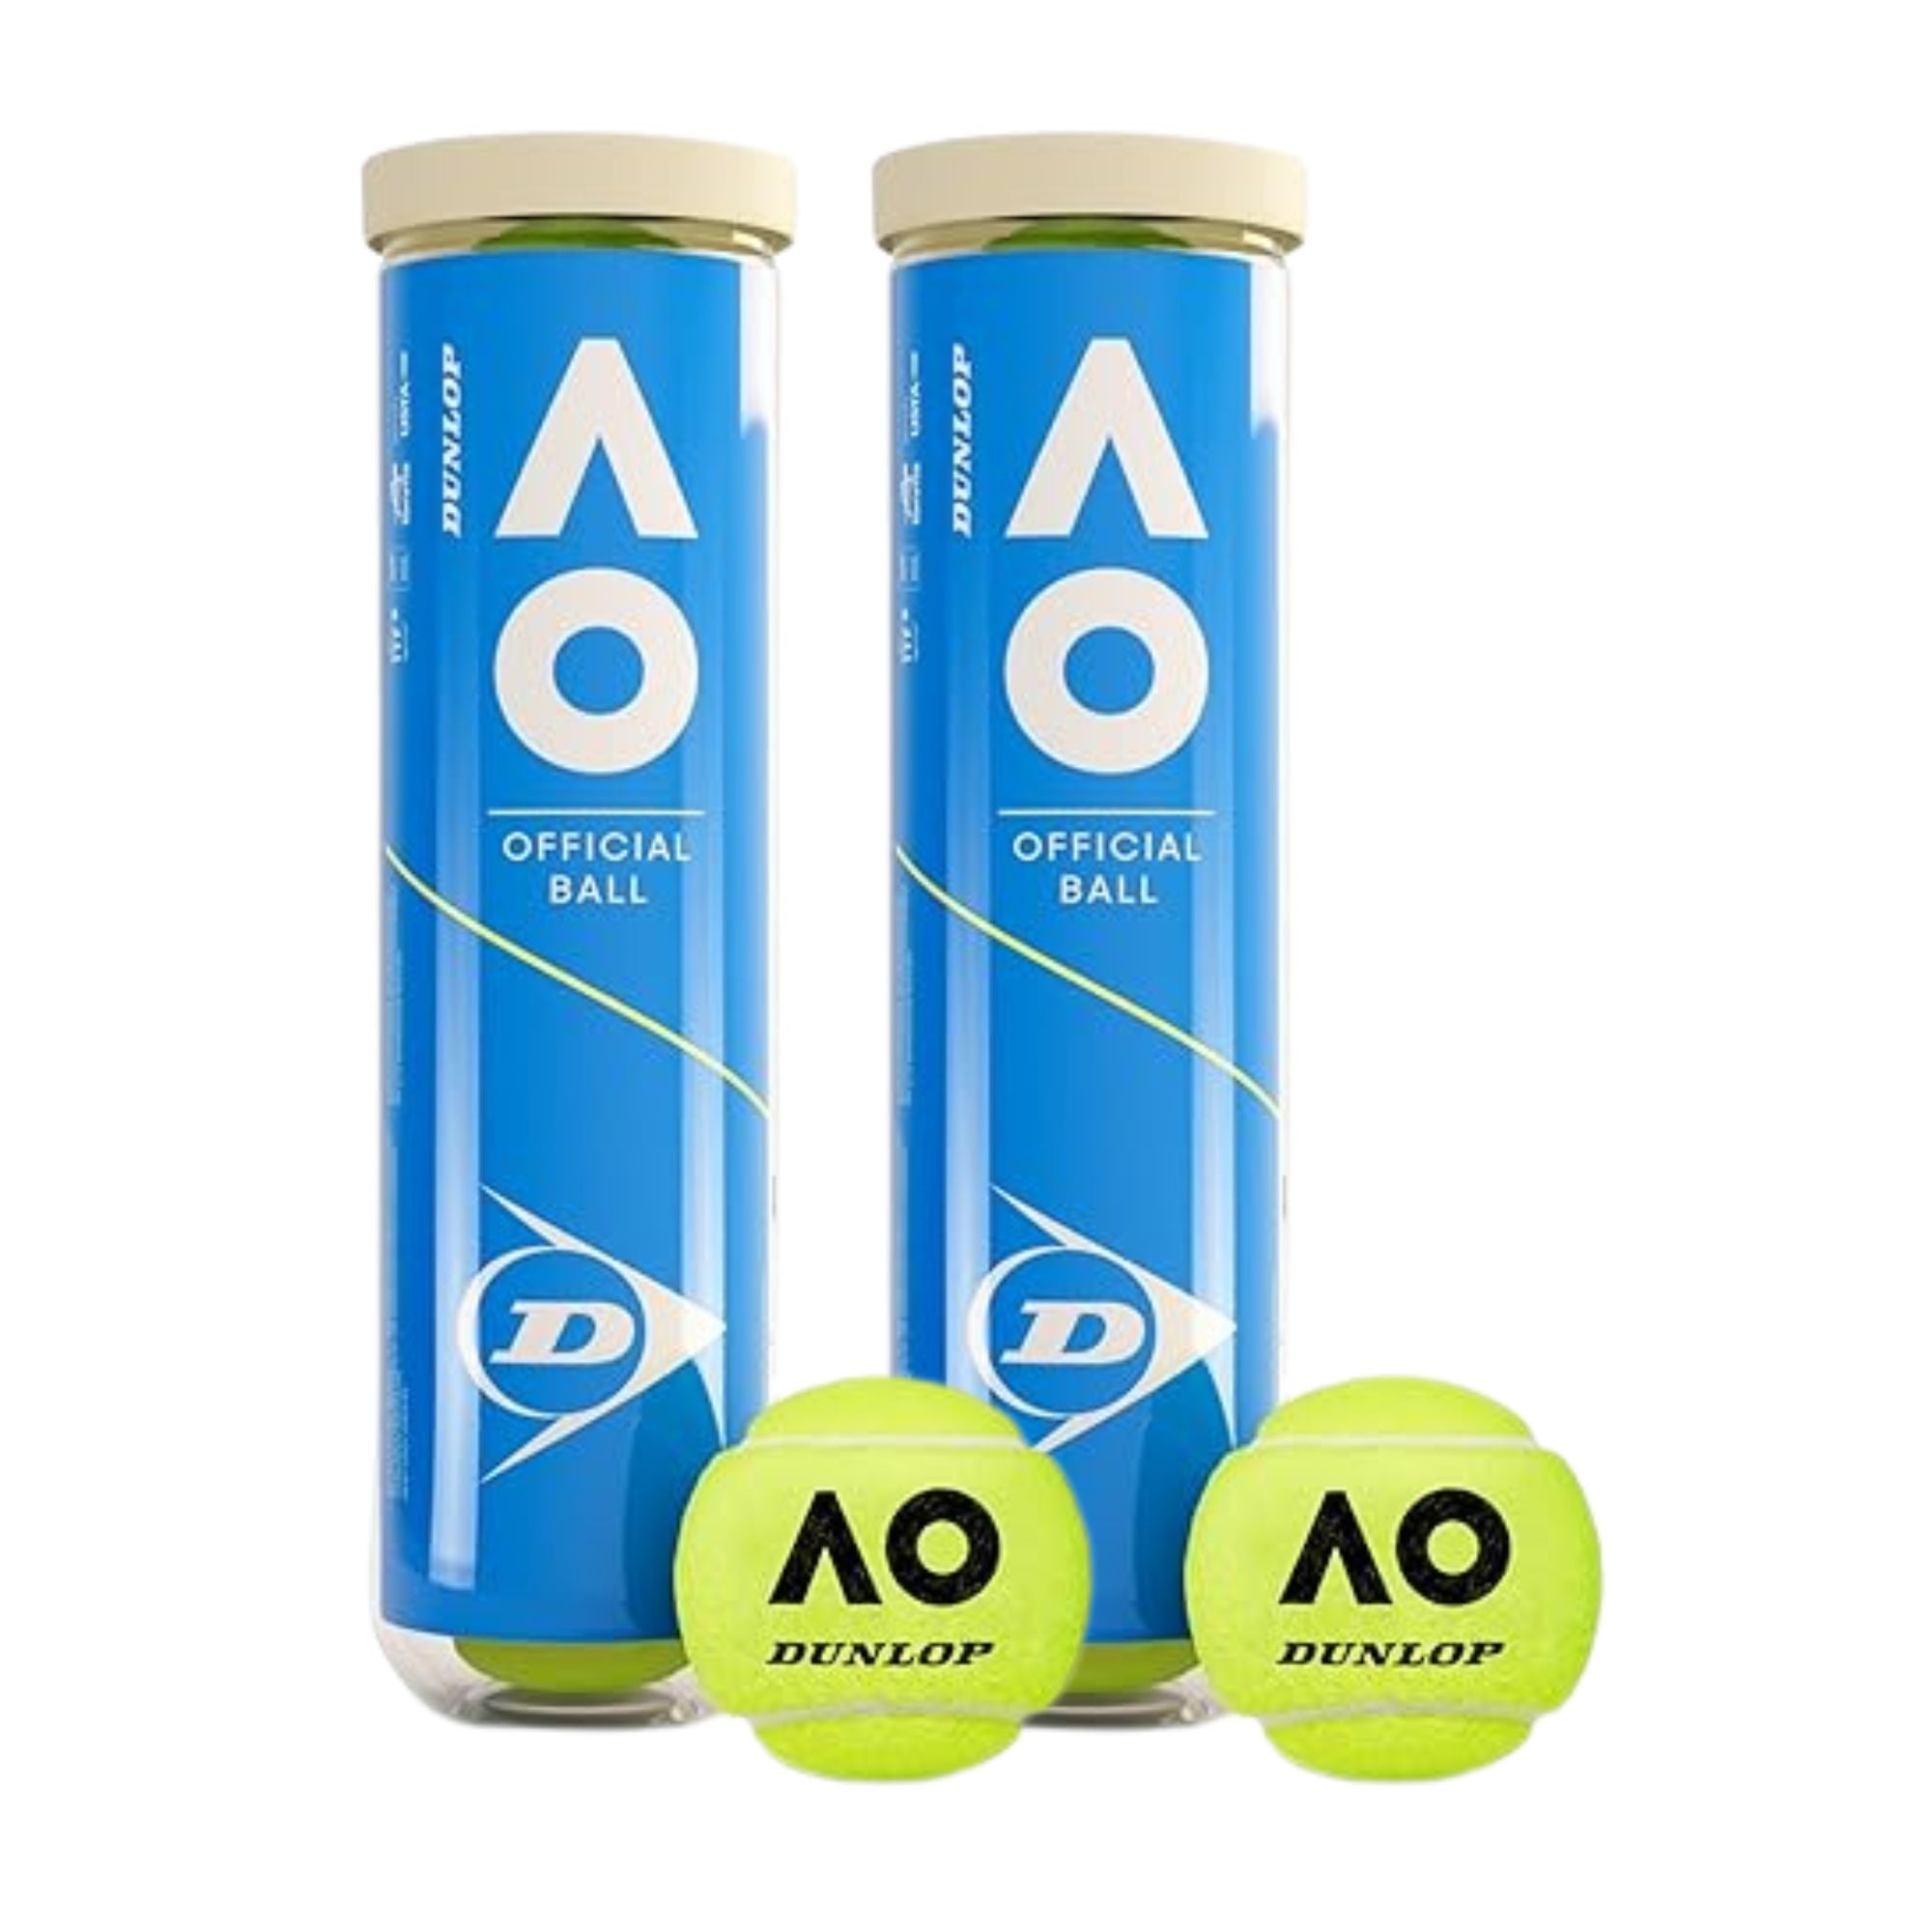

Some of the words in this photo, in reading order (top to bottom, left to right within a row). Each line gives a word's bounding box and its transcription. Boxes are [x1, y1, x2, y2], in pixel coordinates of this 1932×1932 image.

[441, 343, 462, 539] DUNLOP
[952, 343, 972, 539] DUNLOP
[502, 831, 692, 862] OFFICIAL
[1012, 831, 1202, 862] OFFICIAL
[550, 874, 647, 904] BALL
[1060, 874, 1157, 904] BALL
[489, 1298, 636, 1365] D
[999, 1298, 1146, 1365] D
[767, 1488, 1001, 1607] AO
[1277, 1488, 1511, 1607] AO
[766, 1641, 995, 1666] DUNLOP
[1276, 1641, 1505, 1666] DUNLOP
